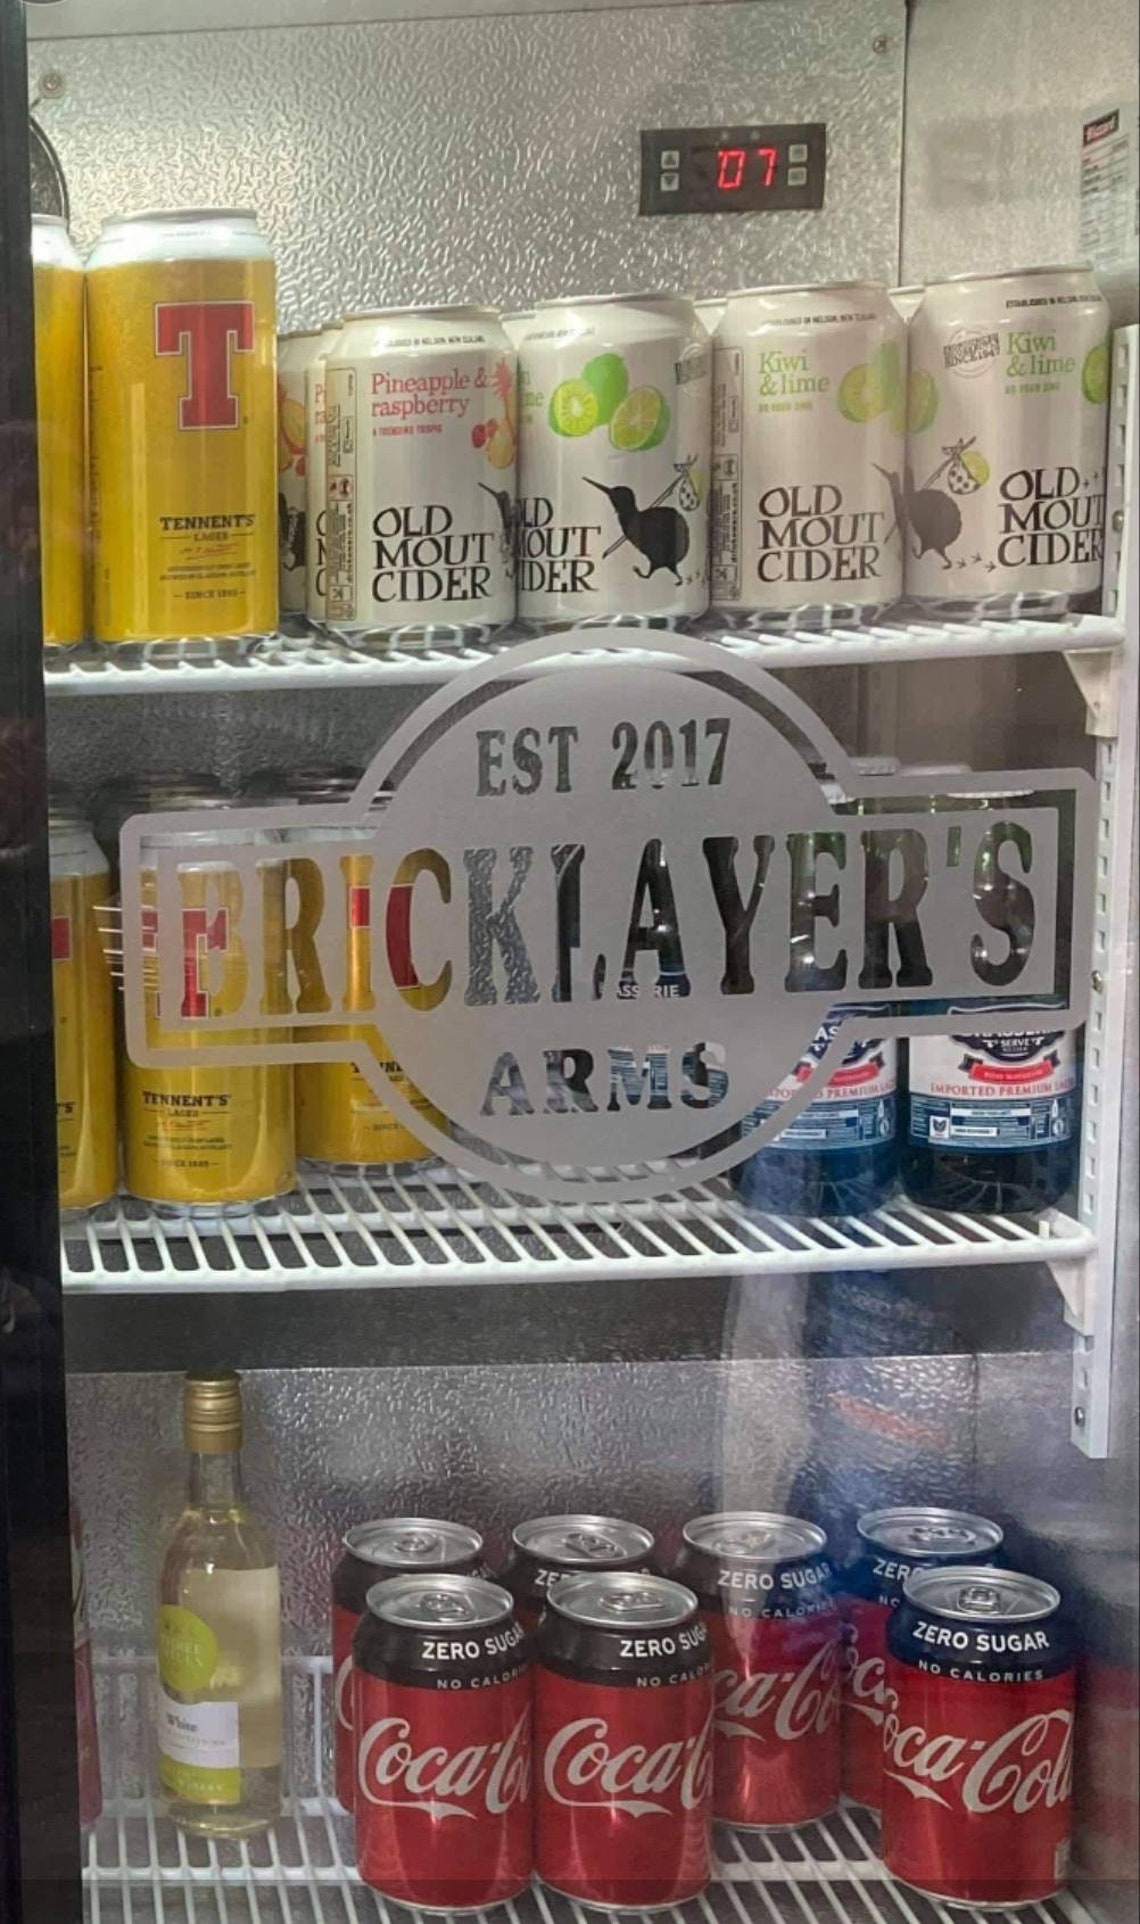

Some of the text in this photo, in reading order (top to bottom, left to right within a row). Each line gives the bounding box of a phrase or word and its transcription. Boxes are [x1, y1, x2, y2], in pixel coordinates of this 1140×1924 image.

[718, 147, 778, 188] 07
[1006, 329, 1057, 355] Kiwi
[155, 300, 255, 430] T
[759, 348, 809, 374] Kiwi
[1006, 353, 1075, 377] & lime
[371, 366, 488, 397] Pineapple &
[760, 373, 829, 396] & lime
[371, 393, 470, 420] raspberry
[999, 466, 1080, 501] OLD
[519, 497, 553, 528] LD
[758, 484, 843, 518] OLD
[371, 504, 453, 538] OLD
[757, 511, 885, 550] MOUT
[371, 532, 494, 570] MOUT
[518, 526, 601, 558] OUT
[518, 560, 600, 593] IDER
[757, 545, 883, 583] CIDER
[371, 566, 493, 602] CIDER
[476, 717, 731, 797] EST 2017
[177, 820, 1036, 1019] BRICKLAYER'S
[480, 1041, 730, 1117] ARMS
[931, 1082, 995, 1096] IMPORTED
[999, 1081, 1051, 1096] PREMIUM
[142, 1090, 232, 1107] TENNENT'S
[717, 1561, 833, 1591] ZERO SUGAR
[728, 1606, 751, 1618] NO
[421, 1638, 480, 1660] ZERO
[620, 1623, 708, 1659] ZERO SUG
[912, 1620, 1050, 1652] ZERO SUGAR
[437, 1677, 462, 1690] NO
[636, 1676, 661, 1689] NO
[918, 1659, 1044, 1681] NO CALORIES
[166, 1712, 198, 1732] White
